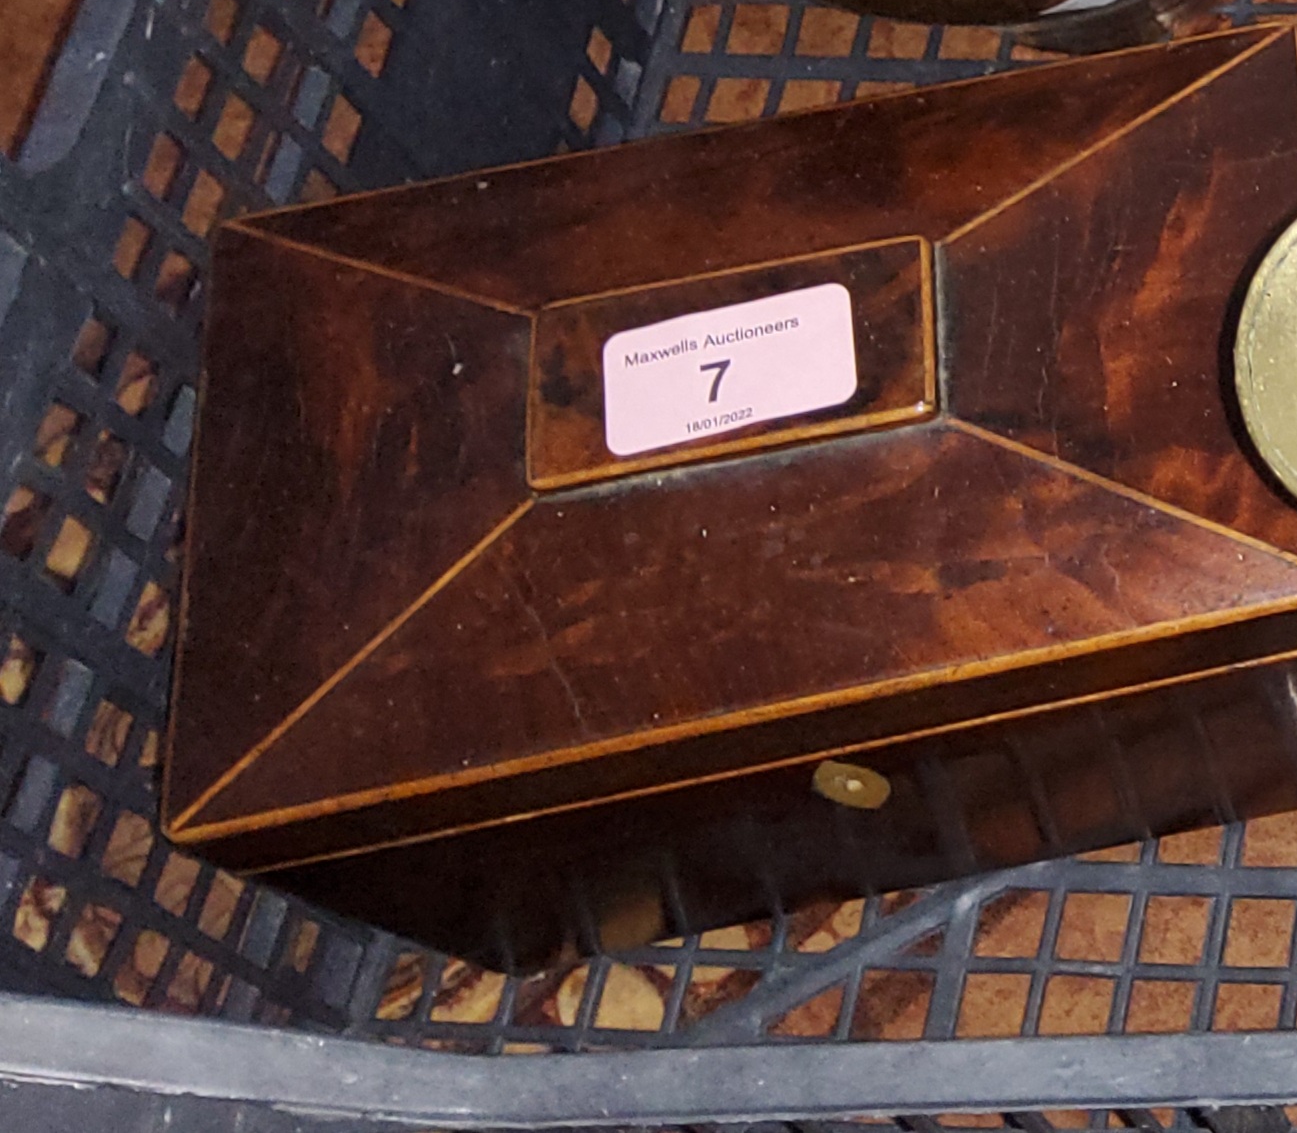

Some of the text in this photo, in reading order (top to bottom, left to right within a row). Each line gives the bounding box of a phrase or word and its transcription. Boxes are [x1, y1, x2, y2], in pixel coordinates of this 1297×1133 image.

[624, 316, 800, 368] Maxwells Auctioneers
[700, 359, 731, 403] 7
[686, 407, 753, 434] 18/01/2022
